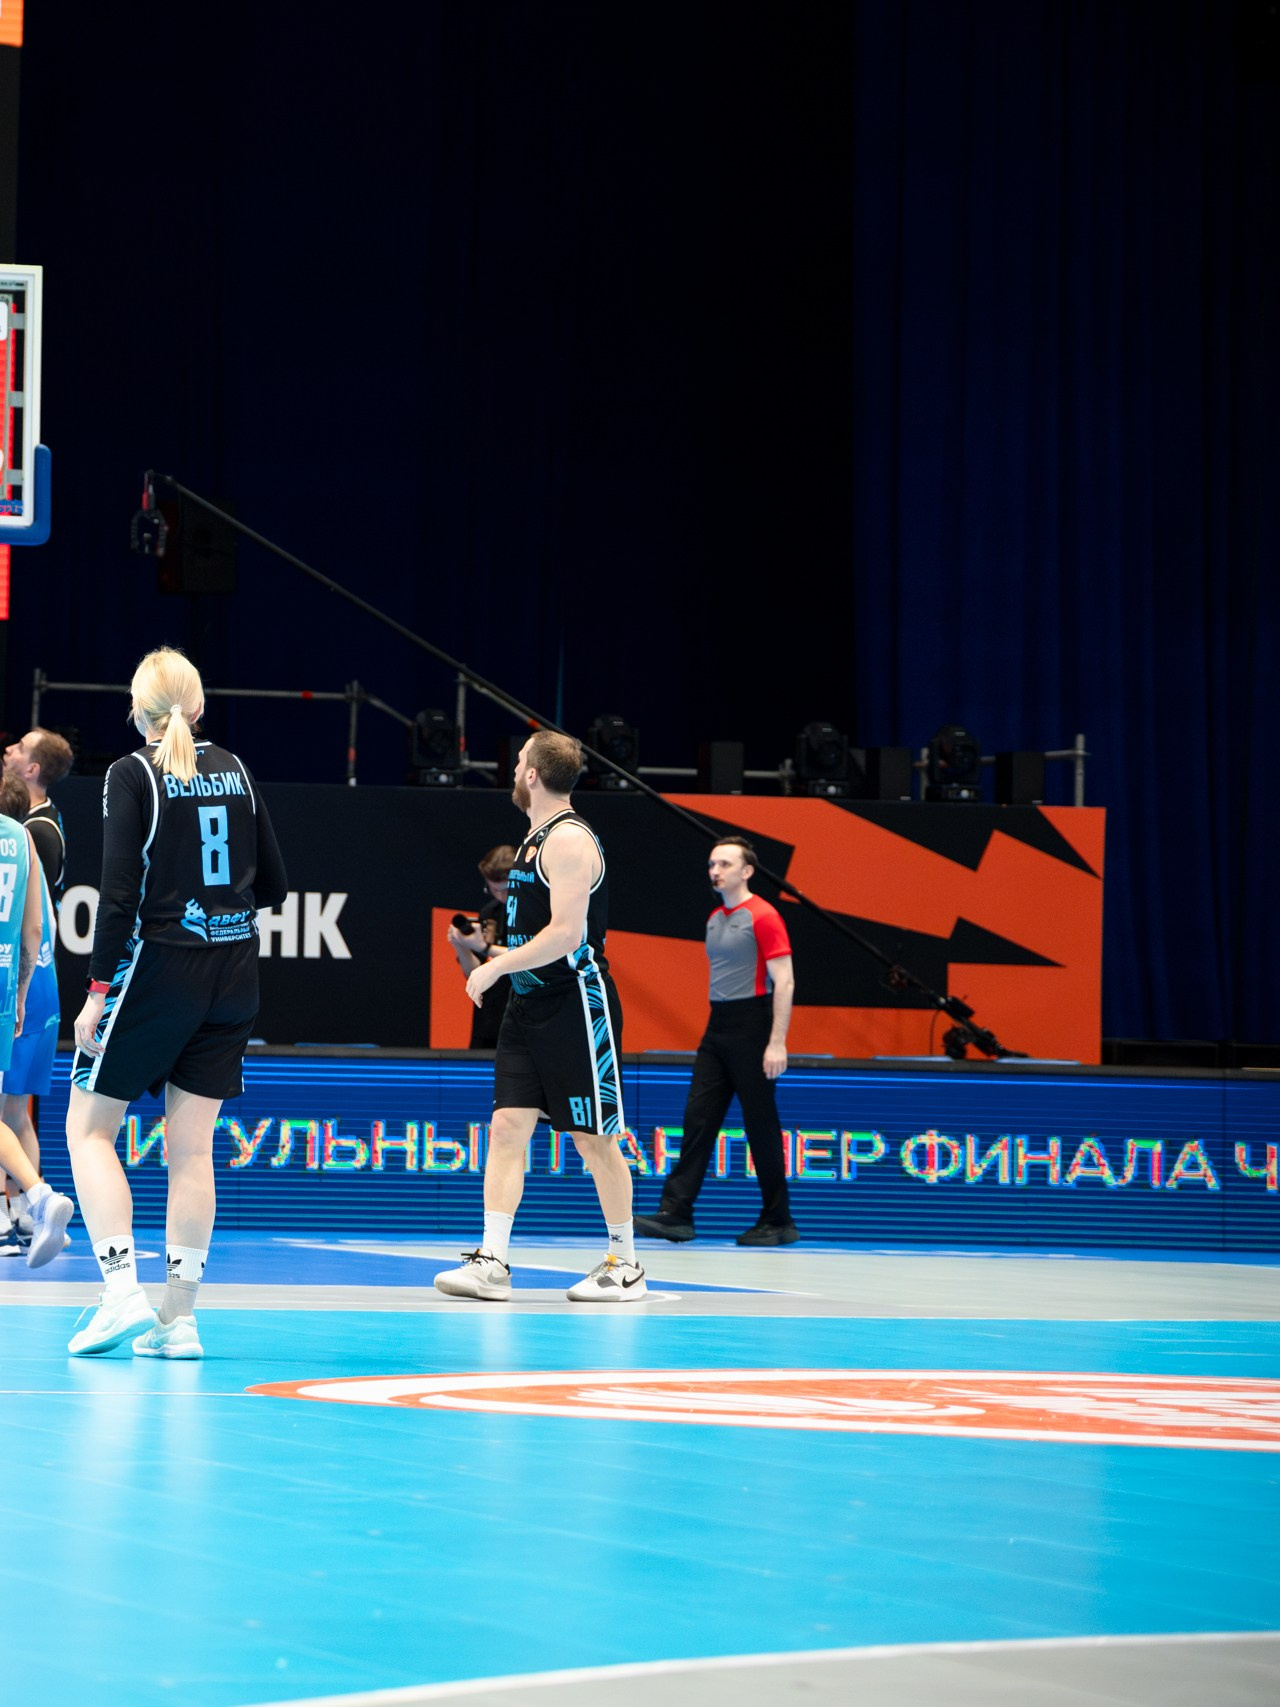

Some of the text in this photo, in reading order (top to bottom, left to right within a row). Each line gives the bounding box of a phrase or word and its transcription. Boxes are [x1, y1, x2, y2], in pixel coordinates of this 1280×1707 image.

[162, 771, 246, 799] ВЕЛЬБИК
[197, 805, 231, 886] 8
[208, 911, 250, 926] ДВФУ
[569, 1096, 593, 1128] 81
[900, 1130, 1220, 1191] ФИНАЛА
[104, 1262, 131, 1274] adidas
